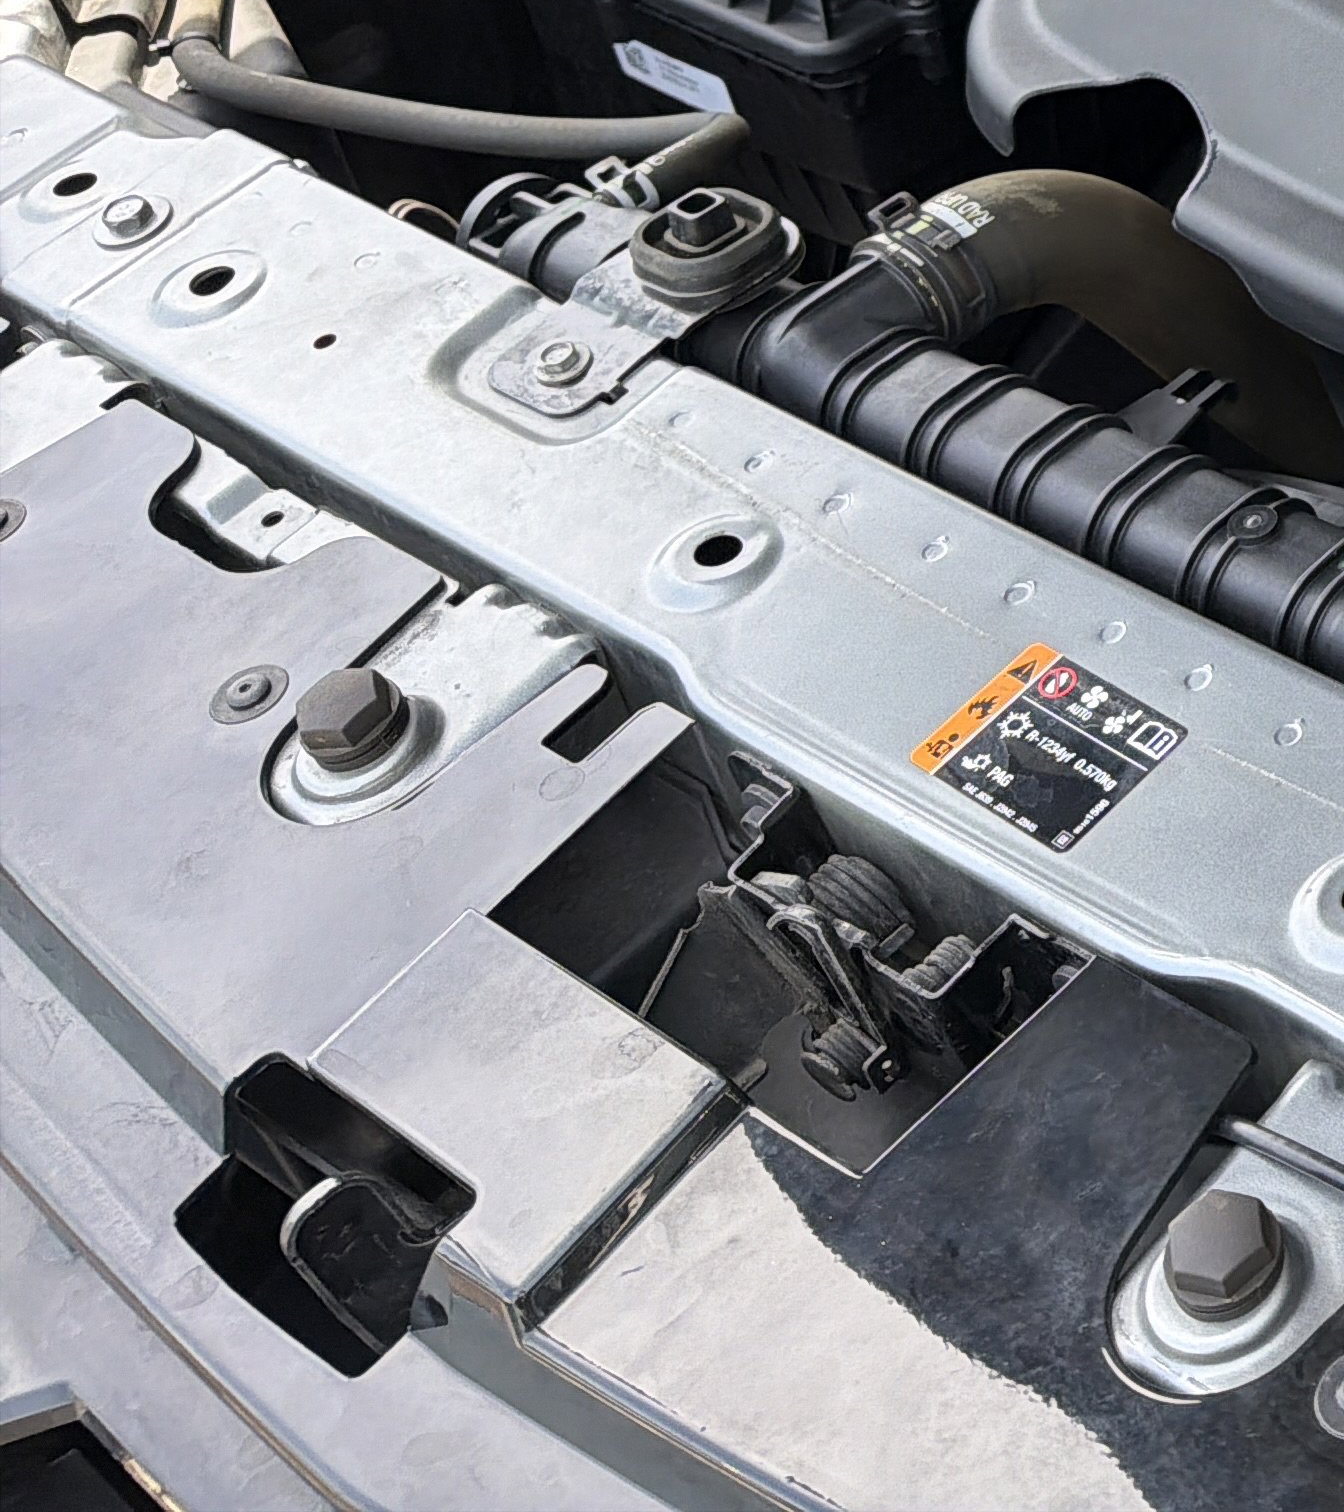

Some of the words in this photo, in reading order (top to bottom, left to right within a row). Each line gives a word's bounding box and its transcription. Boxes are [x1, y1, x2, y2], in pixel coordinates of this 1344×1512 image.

[1065, 702, 1093, 722] AUTO
[1025, 729, 1077, 764] R-1234yf
[1073, 754, 1117, 793] 0.570kg
[987, 765, 1014, 788] PAG
[962, 781, 979, 795] SAE
